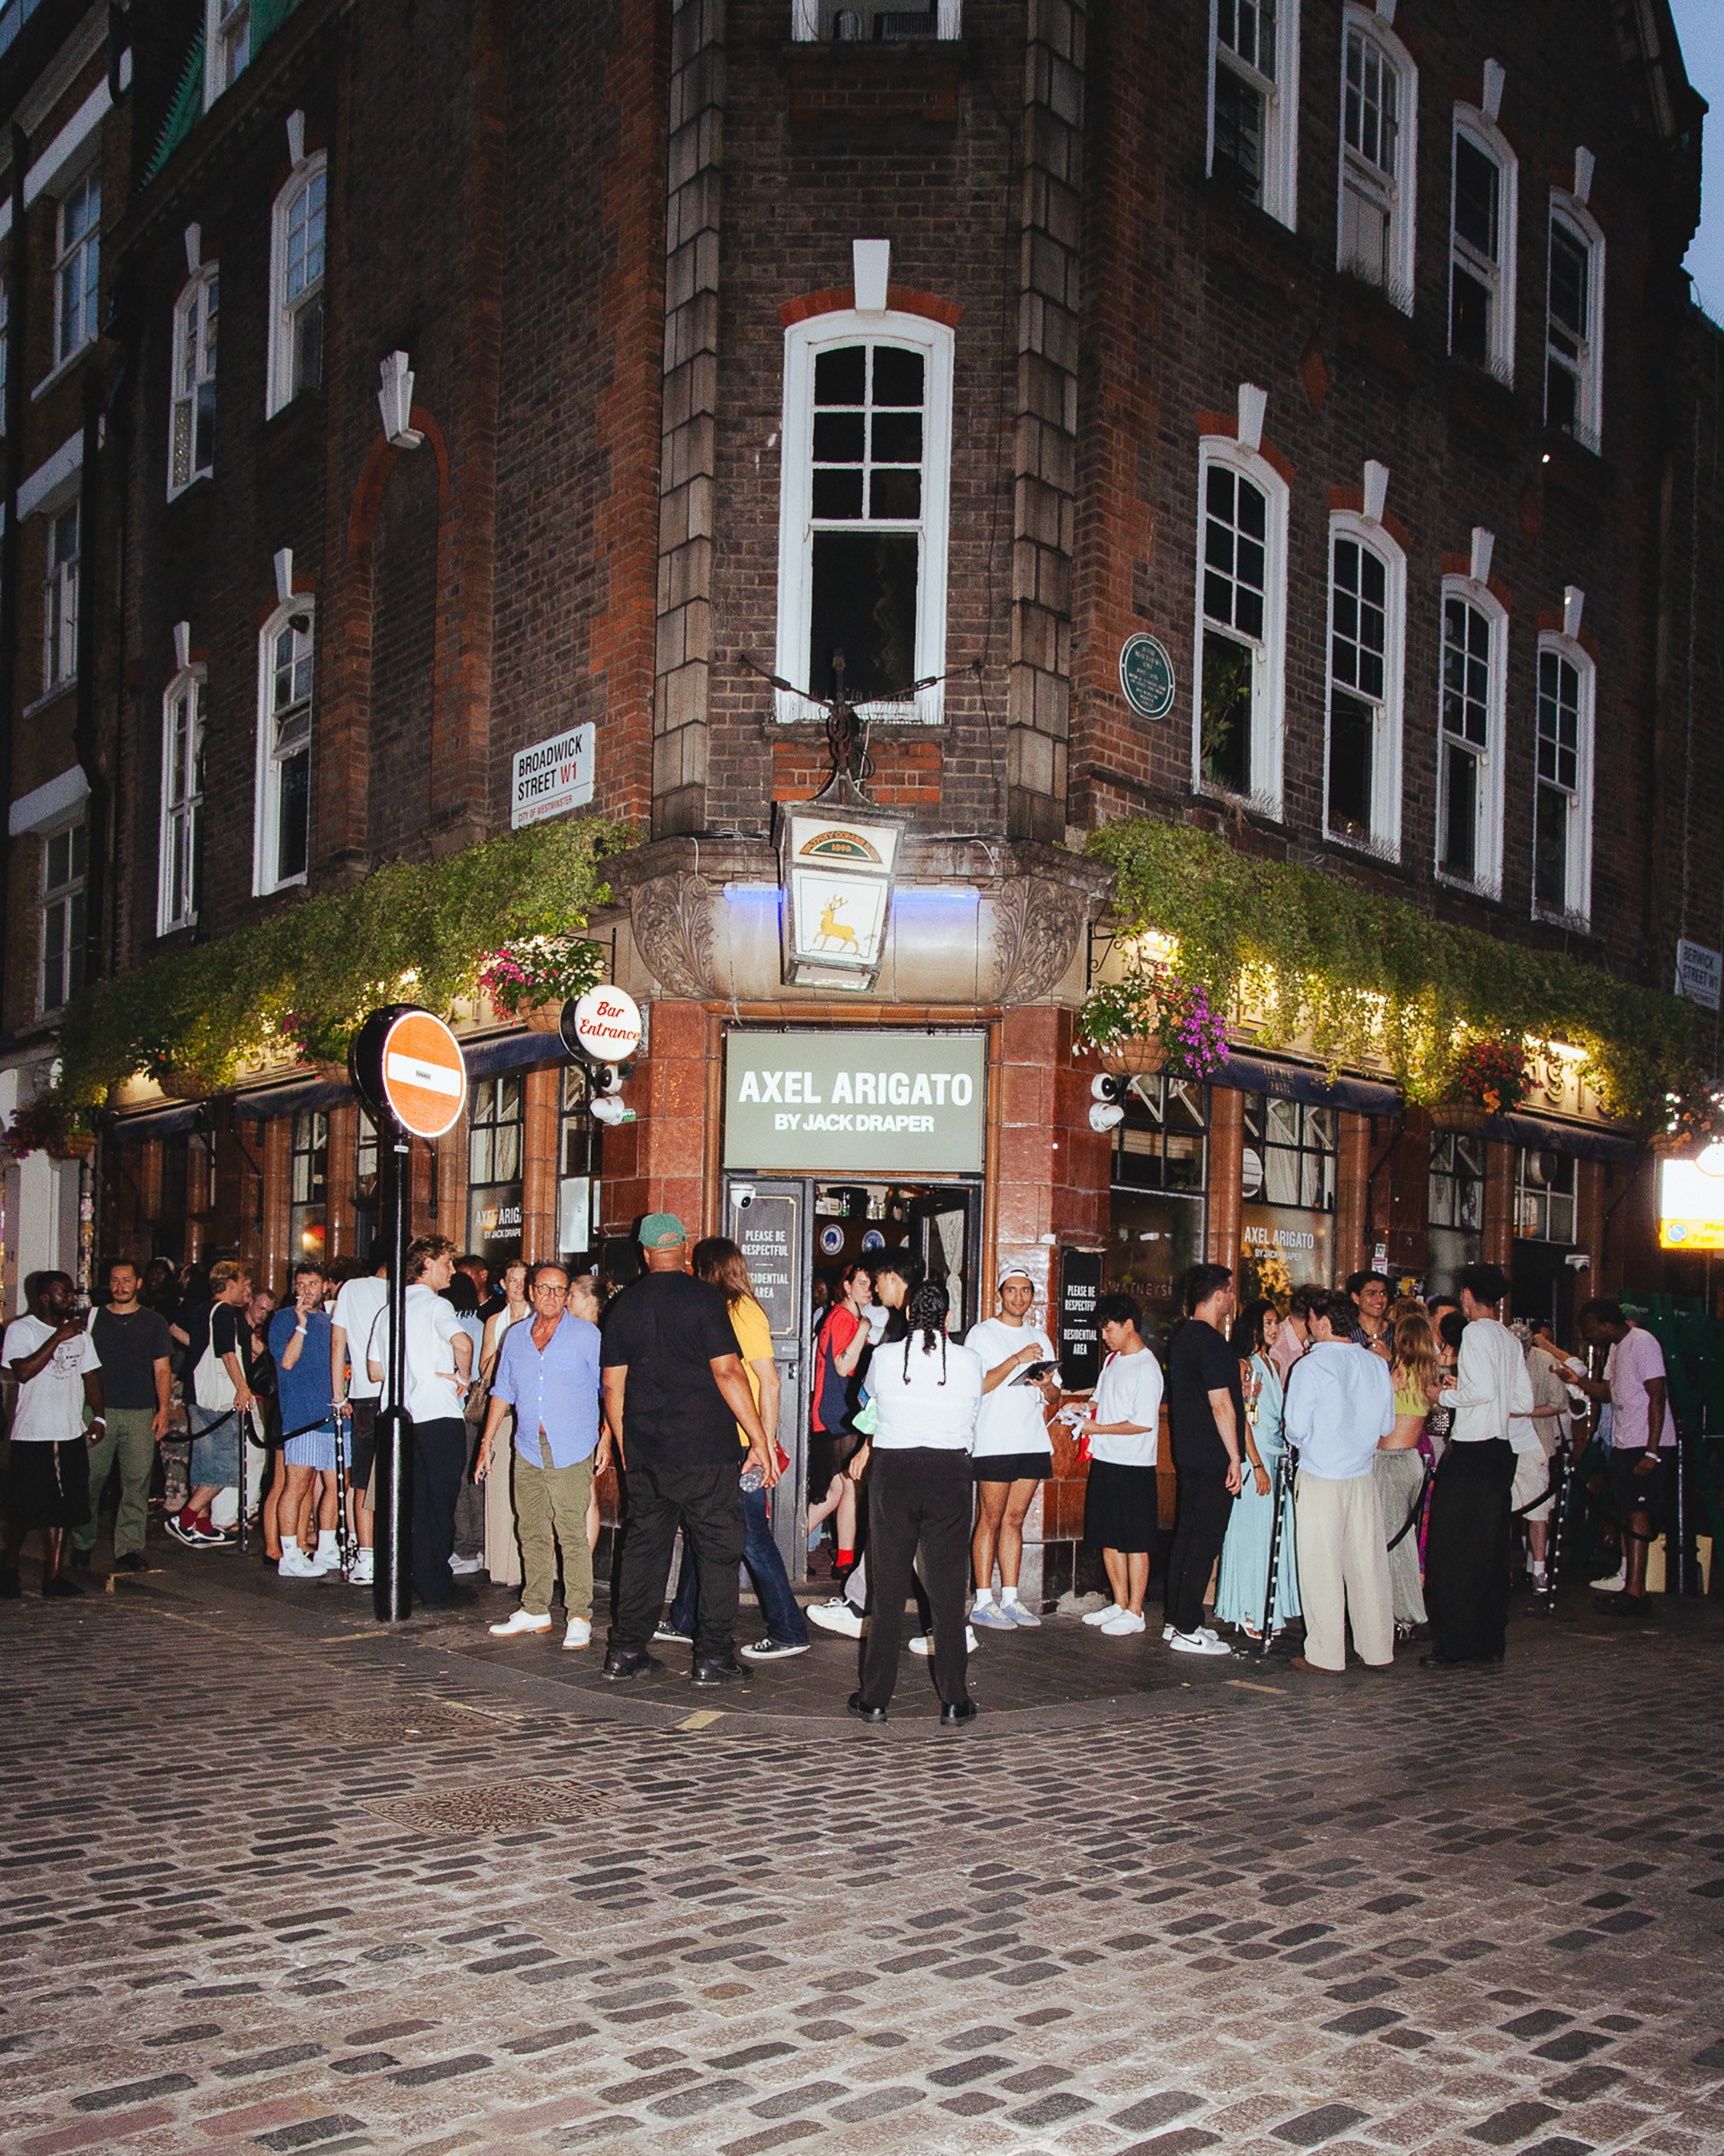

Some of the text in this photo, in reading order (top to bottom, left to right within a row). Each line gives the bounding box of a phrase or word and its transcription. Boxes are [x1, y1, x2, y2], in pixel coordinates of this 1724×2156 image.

[519, 735, 582, 778] BROADWICK
[518, 761, 576, 801] STREET W1
[518, 812, 528, 823] CITY
[538, 795, 572, 814] WESTMINSTER
[597, 1001, 624, 1017] Bar
[579, 1018, 639, 1041] Entrance
[739, 1070, 972, 1106] AXEL ARIGATO
[774, 1113, 934, 1132] BY JACK DRAPER
[475, 1210, 497, 1227] AXEL
[484, 1230, 491, 1240] BY
[745, 1230, 786, 1242] PLEASE BE
[1244, 1226, 1315, 1250] AXEL ARIGATO
[742, 1244, 788, 1256] RESPECTFUL
[1254, 1248, 1263, 1258] BY
[1263, 1249, 1279, 1259] JACK
[747, 1272, 788, 1284] SIDENTIAL
[754, 1287, 773, 1298] AREA
[1067, 1284, 1095, 1298] PLEASE BE
[1064, 1299, 1096, 1312] RESPECTFU
[1063, 1328, 1097, 1341] RESIDENTIAL
[1072, 1343, 1087, 1355] AREA
